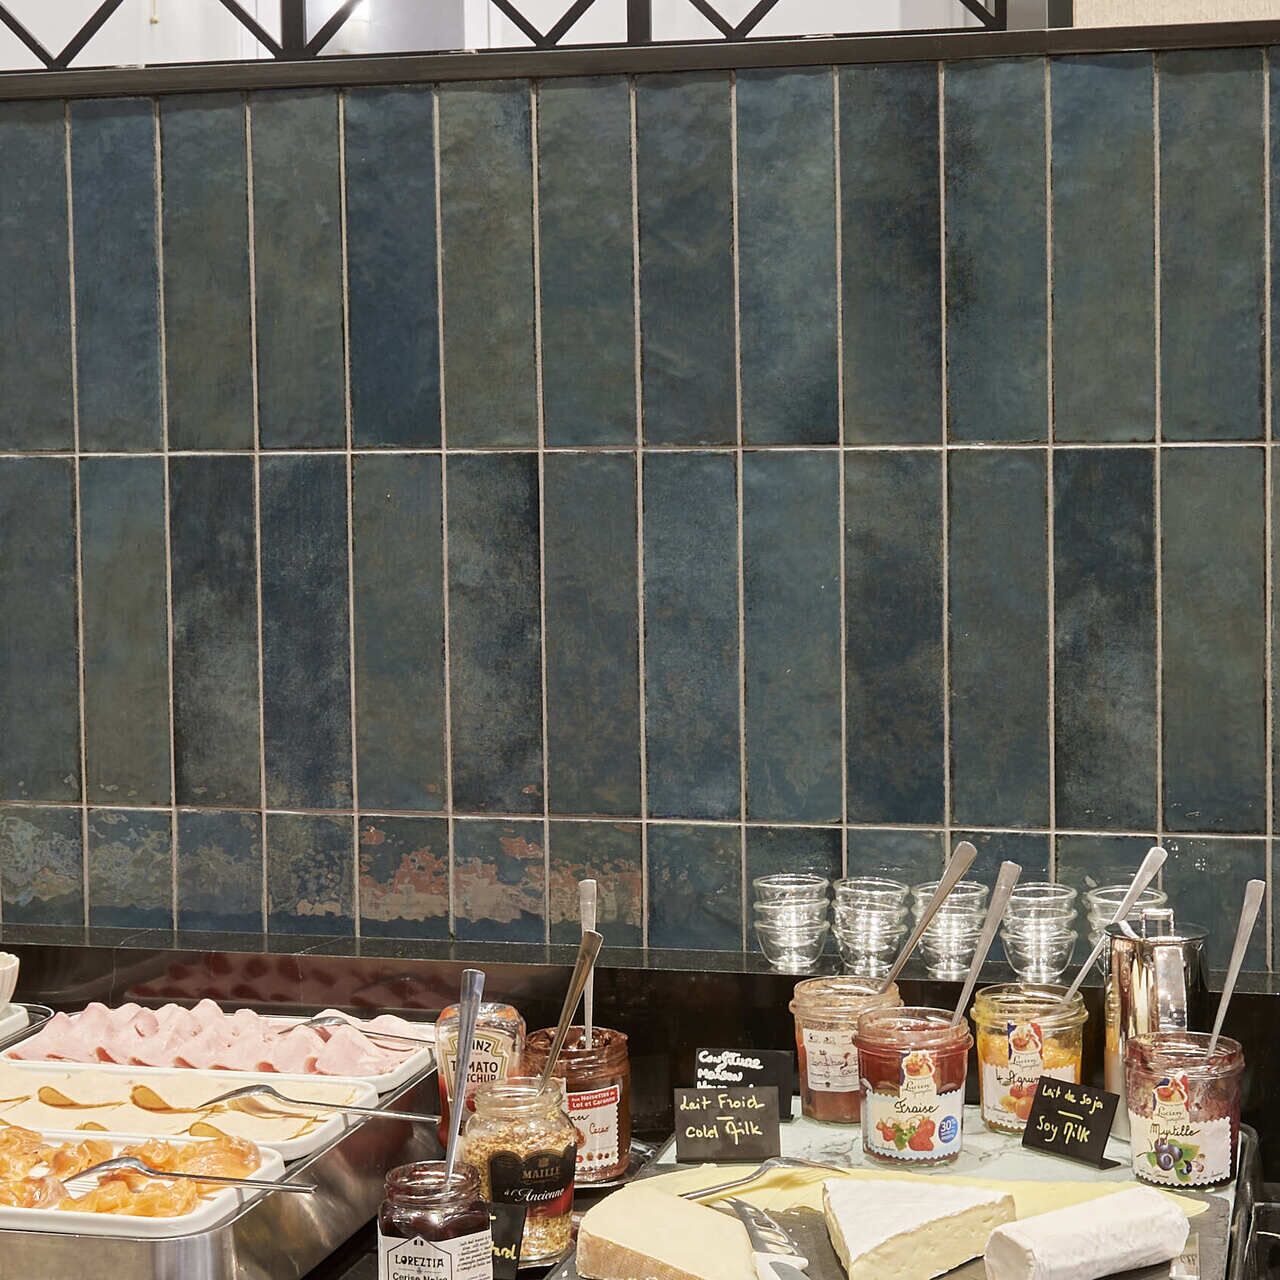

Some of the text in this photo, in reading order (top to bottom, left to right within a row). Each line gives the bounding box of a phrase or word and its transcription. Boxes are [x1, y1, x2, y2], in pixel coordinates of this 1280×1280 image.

[451, 1061, 498, 1074] TMATO
[466, 1073, 497, 1084] TCHUP
[717, 1093, 765, 1109] Froid
[1042, 1084, 1061, 1099] Lait
[1065, 1089, 1076, 1103] de
[894, 1097, 939, 1113] Fraise
[1036, 1115, 1090, 1144] Soy Milk
[1151, 1123, 1201, 1142] Myrtille
[395, 1254, 445, 1268] LOREZTIA
